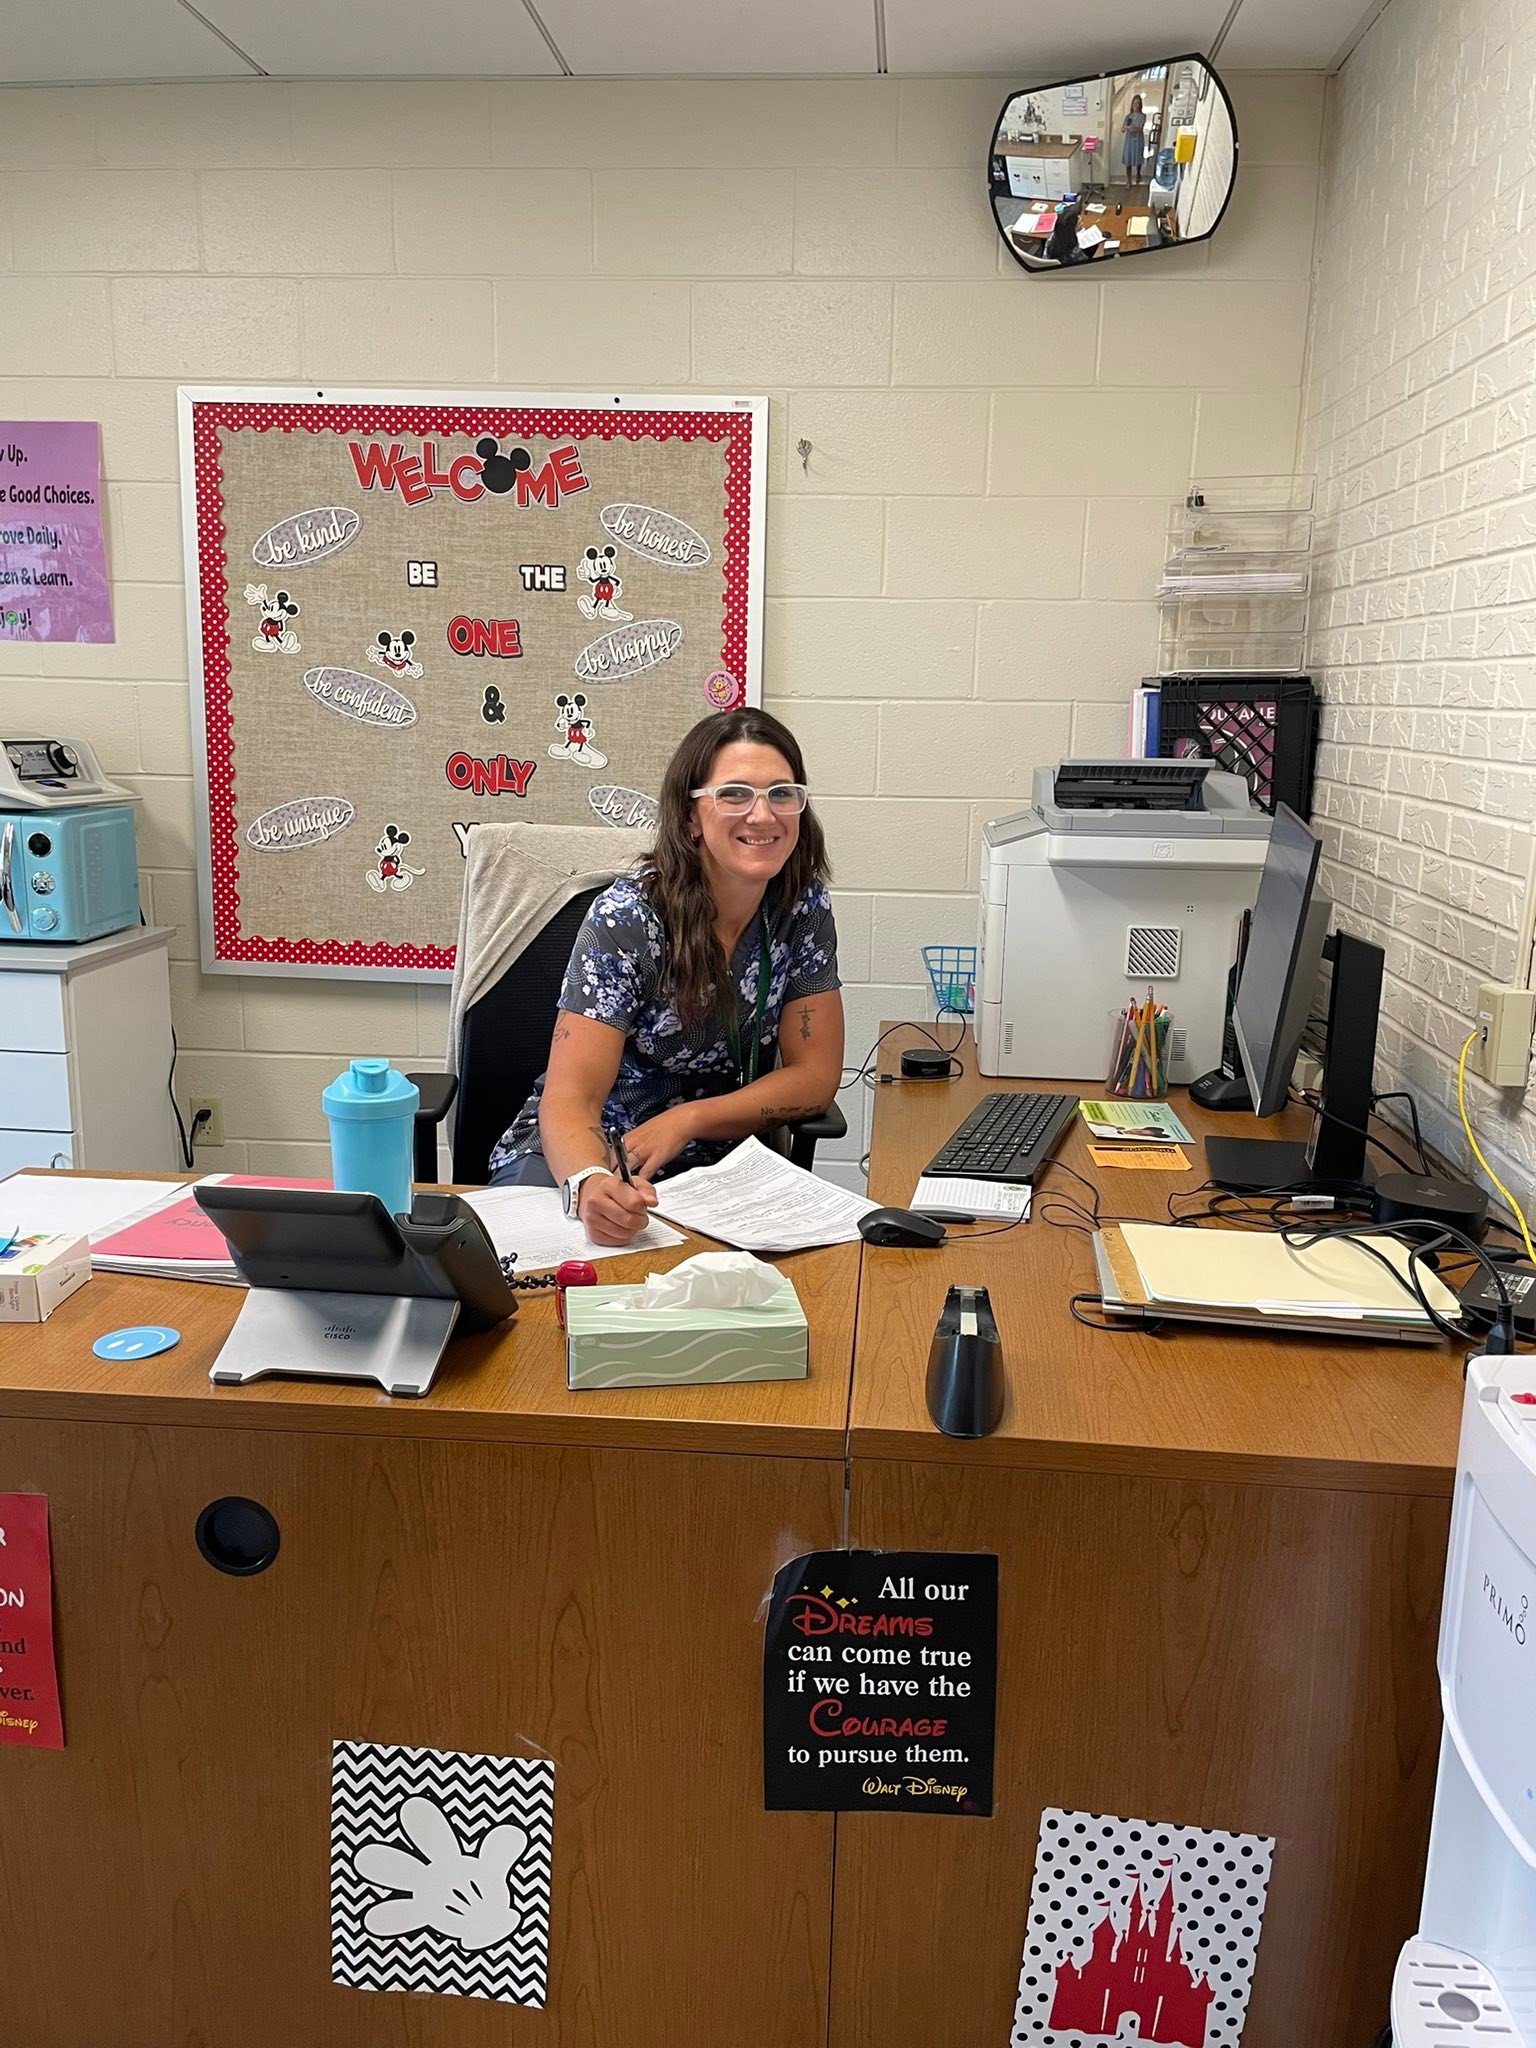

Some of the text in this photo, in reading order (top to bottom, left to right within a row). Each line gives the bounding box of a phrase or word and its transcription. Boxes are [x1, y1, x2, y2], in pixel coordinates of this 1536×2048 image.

[8, 444, 28, 466] Up.
[348, 438, 591, 508] WELCOME
[9, 485, 41, 504] Good
[44, 485, 95, 505] Choices.
[26, 526, 62, 550] Daily.
[264, 510, 351, 564] be kind
[606, 506, 704, 563] be honest
[21, 567, 31, 586] &
[33, 568, 73, 588] Learn.
[408, 561, 566, 591] BE THE
[447, 616, 523, 658] ONE
[581, 628, 674, 676] be happy
[309, 669, 411, 725] be confident
[481, 684, 507, 724] &
[446, 752, 537, 798] ONLY
[593, 788, 624, 820] be
[253, 804, 347, 845] be unique
[877, 1575, 969, 1602] All our
[1483, 1573, 1527, 1646] PRIMO
[0, 1637, 26, 1655] nd
[787, 1644, 972, 1668] can come true
[787, 1669, 971, 1698] if we have the
[787, 1744, 969, 1768] to pursue them.
